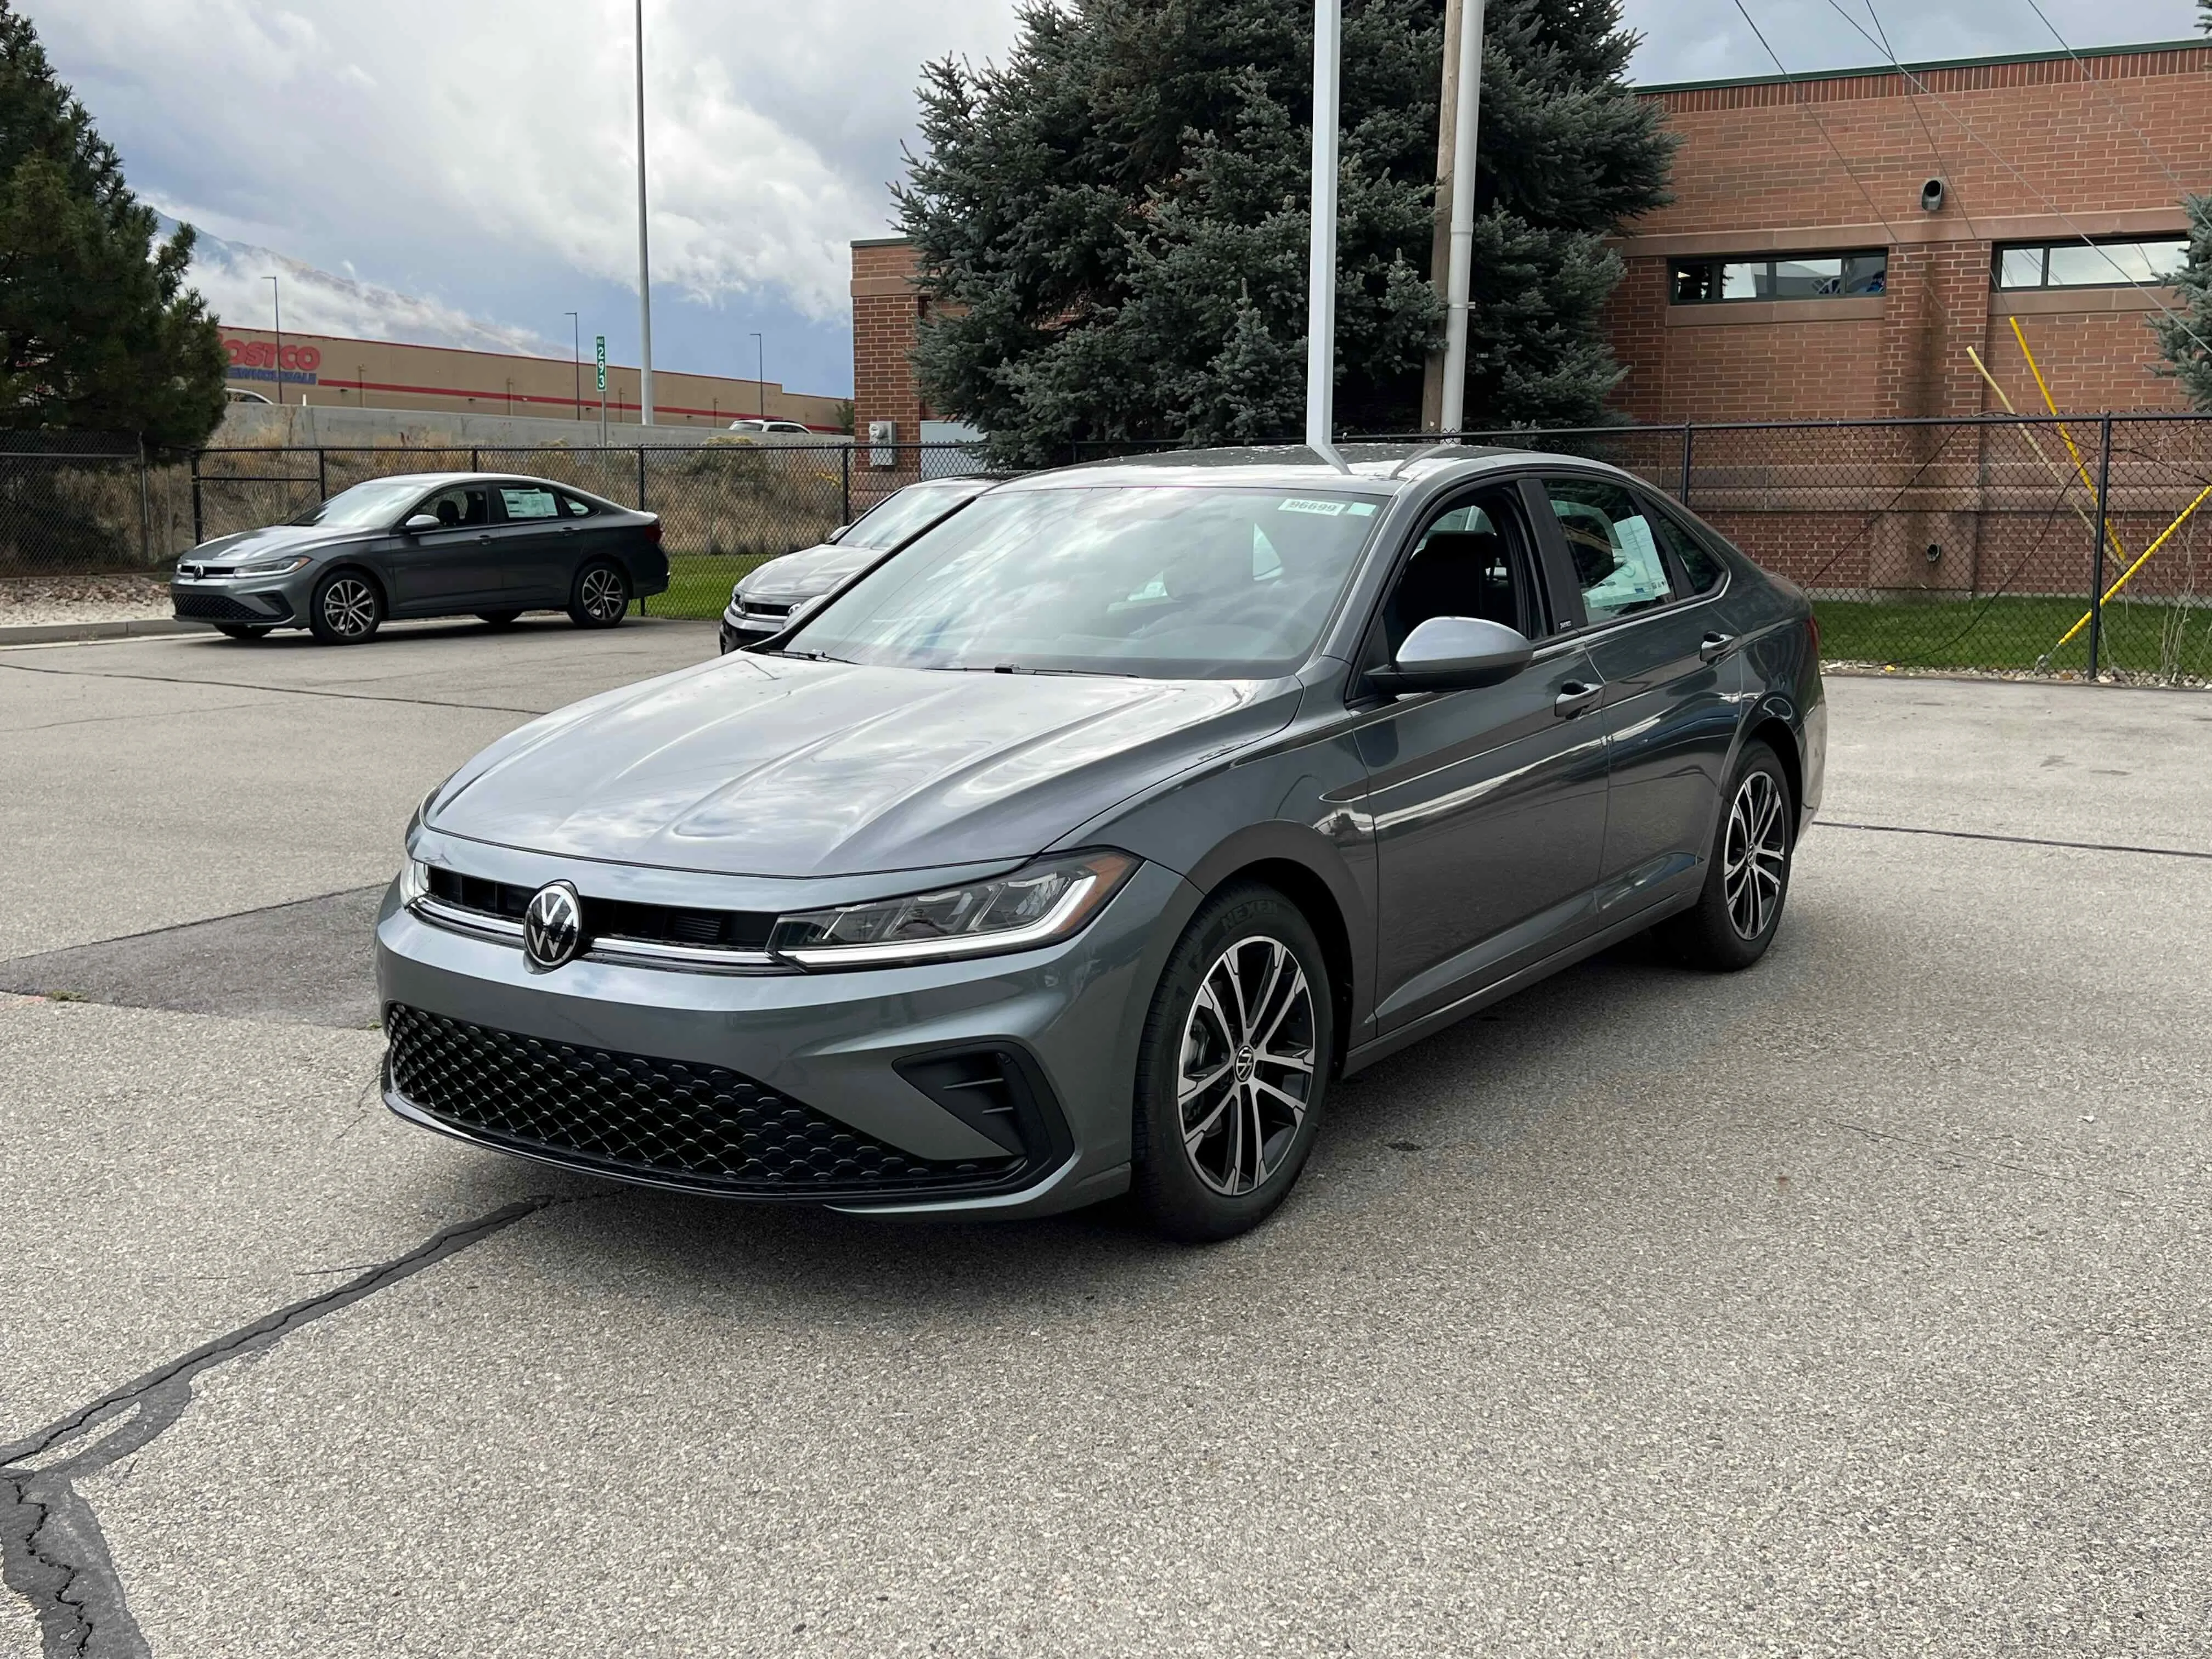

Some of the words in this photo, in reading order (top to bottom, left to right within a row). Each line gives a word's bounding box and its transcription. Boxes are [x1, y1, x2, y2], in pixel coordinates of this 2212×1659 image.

[217, 332, 320, 371] OSTCO
[1290, 501, 1337, 511] 96699
[525, 884, 579, 966] VW
